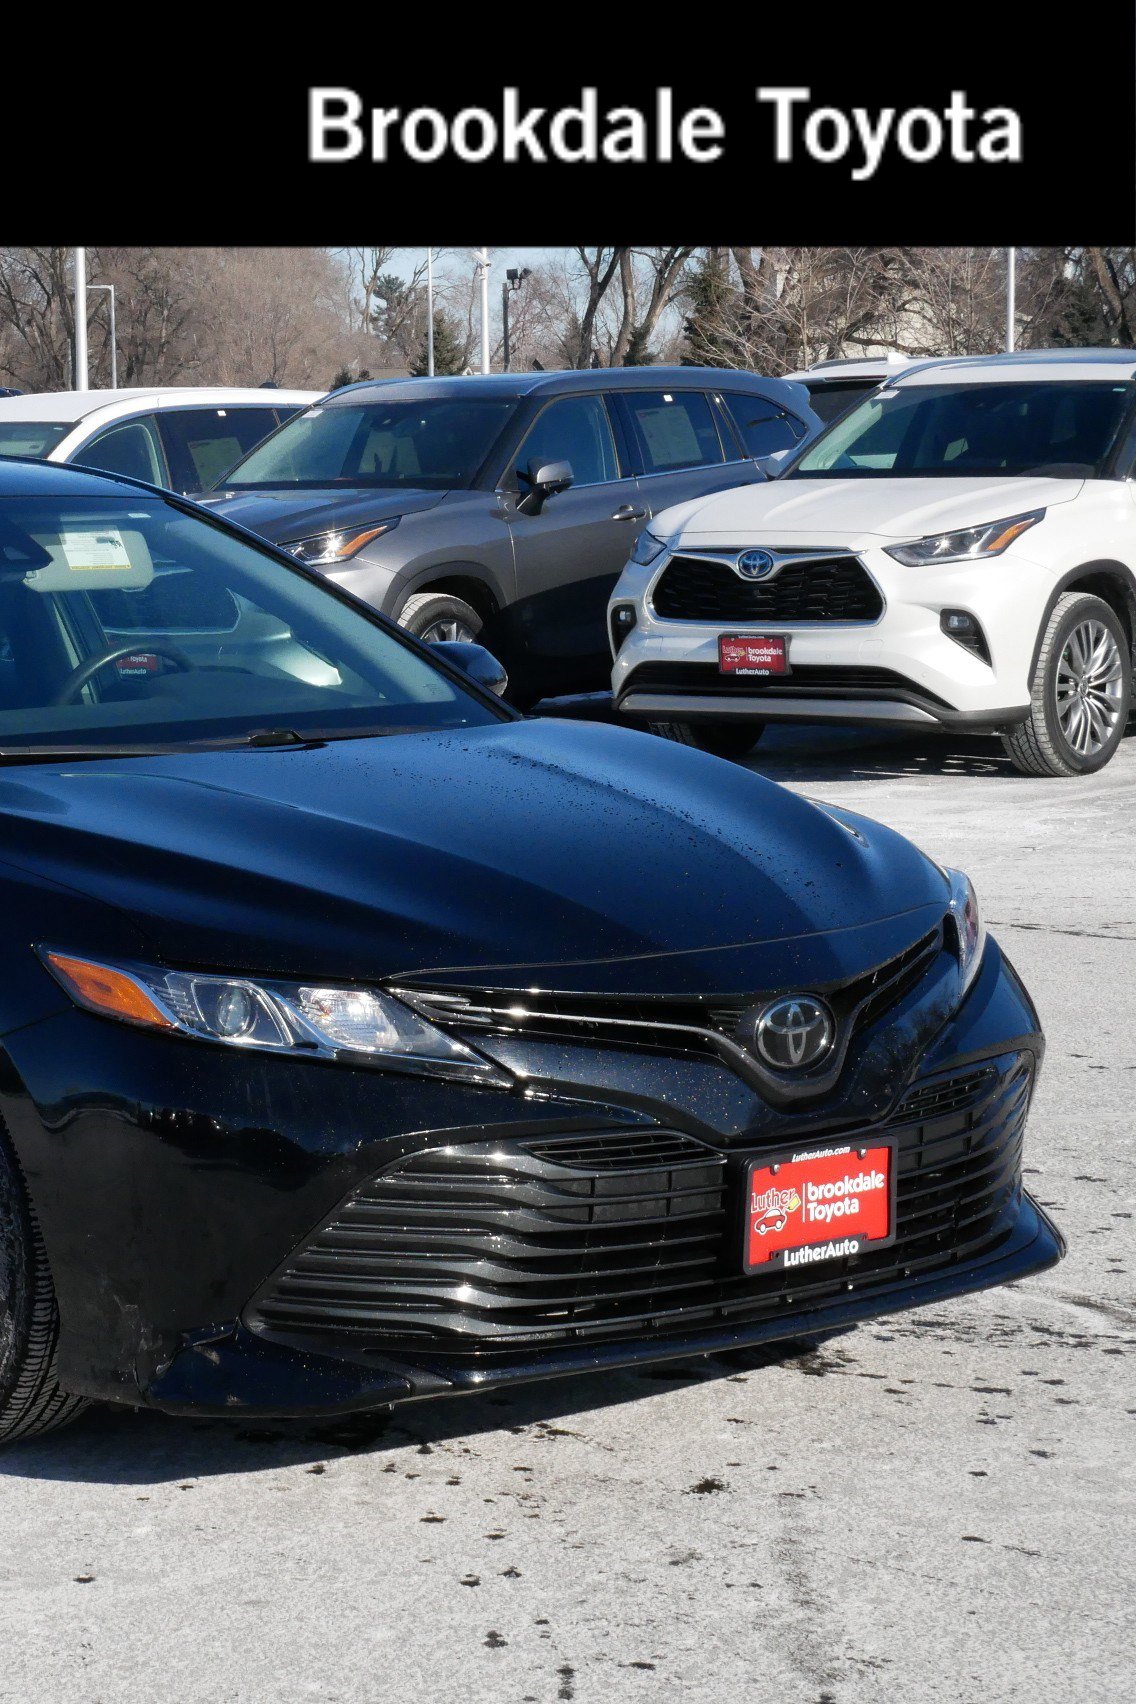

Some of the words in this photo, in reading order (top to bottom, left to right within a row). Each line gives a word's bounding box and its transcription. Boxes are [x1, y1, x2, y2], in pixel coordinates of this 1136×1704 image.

[748, 647, 783, 655] brookdale
[748, 654, 772, 663] Toyota
[791, 1146, 851, 1163] LutherAuto.com
[807, 1170, 885, 1201] brookdale
[751, 1187, 796, 1213] Luther
[807, 1197, 860, 1223] Toyota
[783, 1239, 860, 1267] LutherAuto
